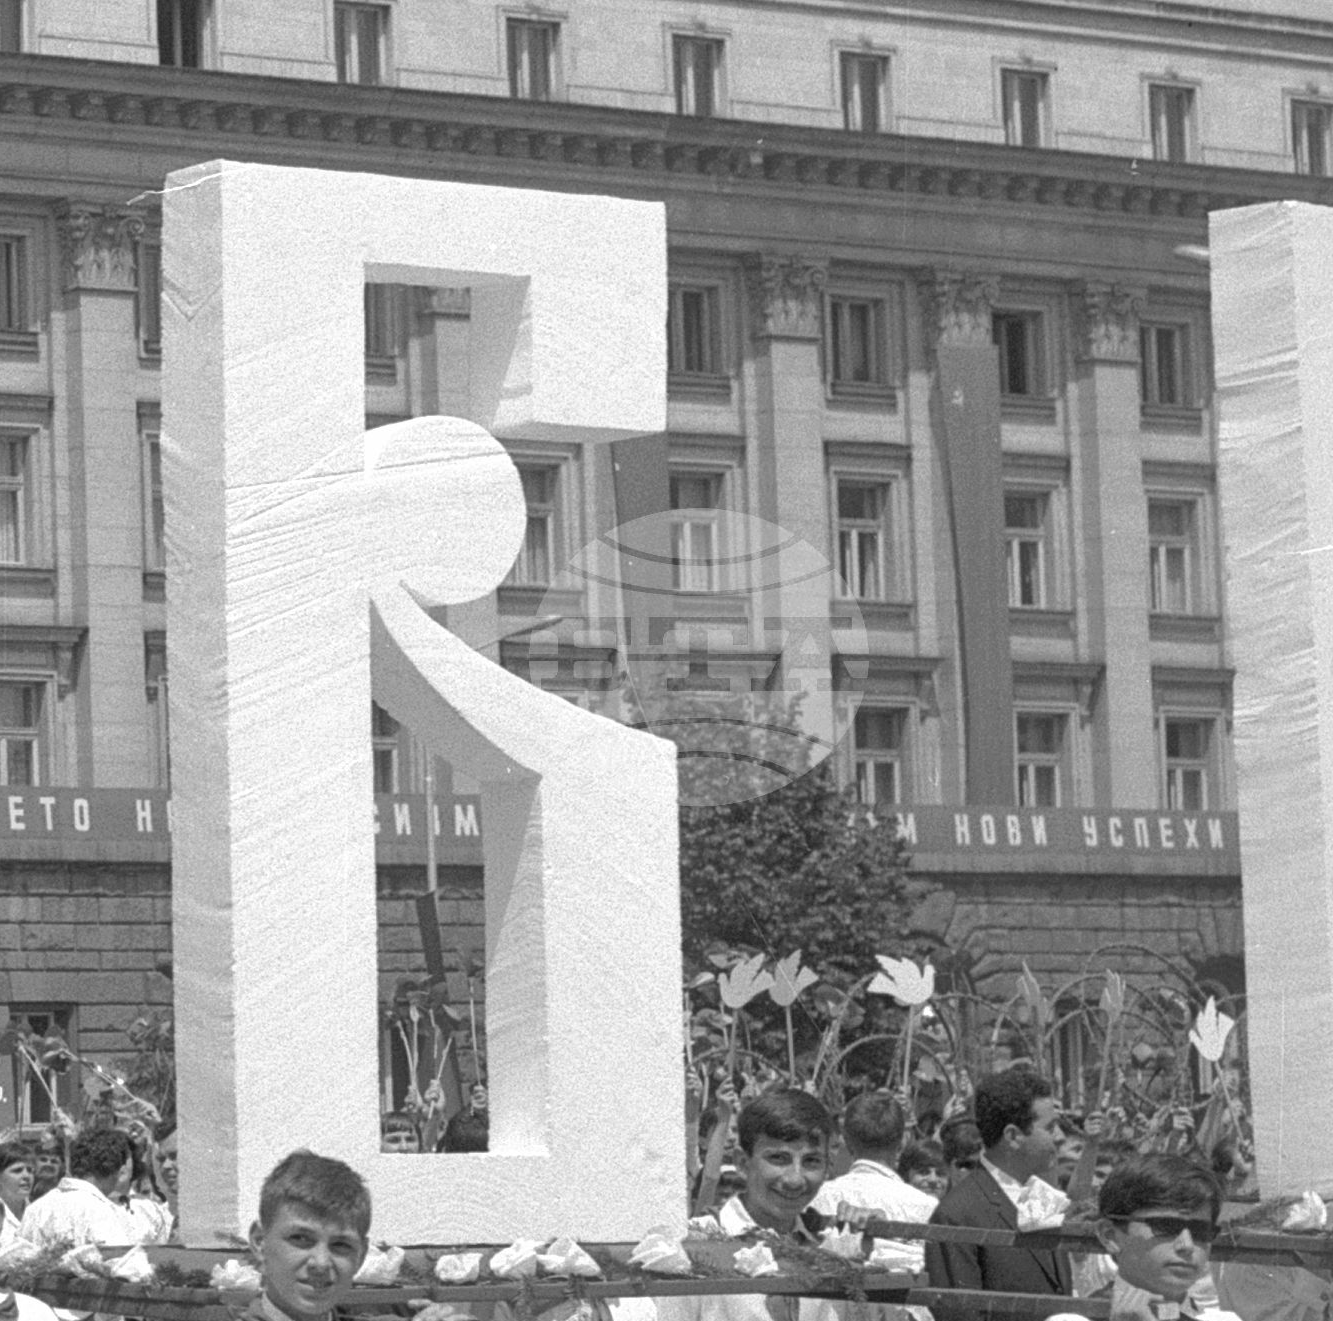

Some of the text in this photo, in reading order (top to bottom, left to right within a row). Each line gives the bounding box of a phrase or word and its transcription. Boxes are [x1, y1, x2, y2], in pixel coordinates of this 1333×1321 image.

[136, 799, 172, 832] Н
[955, 812, 1048, 847] НОВИ
[1081, 815, 1224, 849] УСПЕХИ
